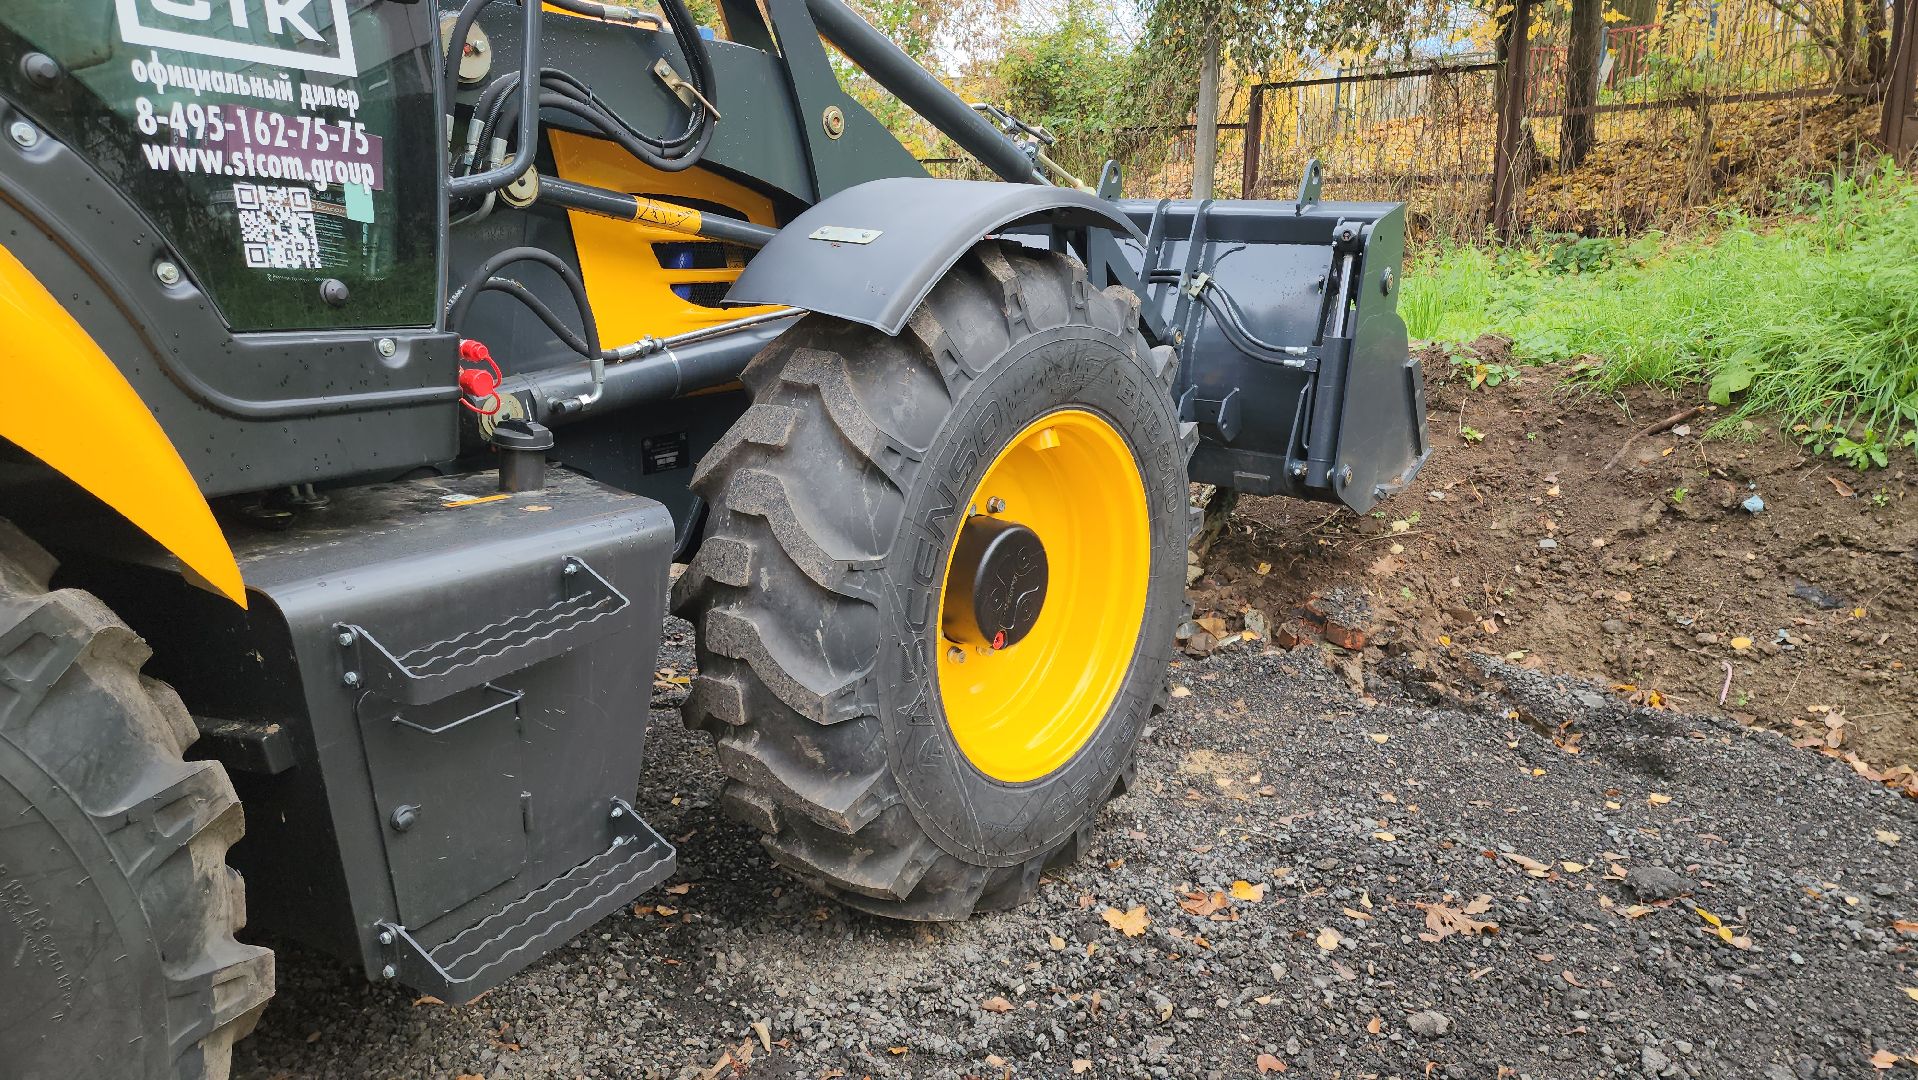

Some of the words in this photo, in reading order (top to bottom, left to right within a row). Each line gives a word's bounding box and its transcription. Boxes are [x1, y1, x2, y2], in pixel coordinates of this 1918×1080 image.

[131, 50, 294, 102] официальный
[300, 83, 360, 118] дилер
[135, 97, 369, 155] 8-495-162-75-75
[141, 144, 375, 195] www.stcom.group
[897, 399, 1001, 726] ASCENSO
